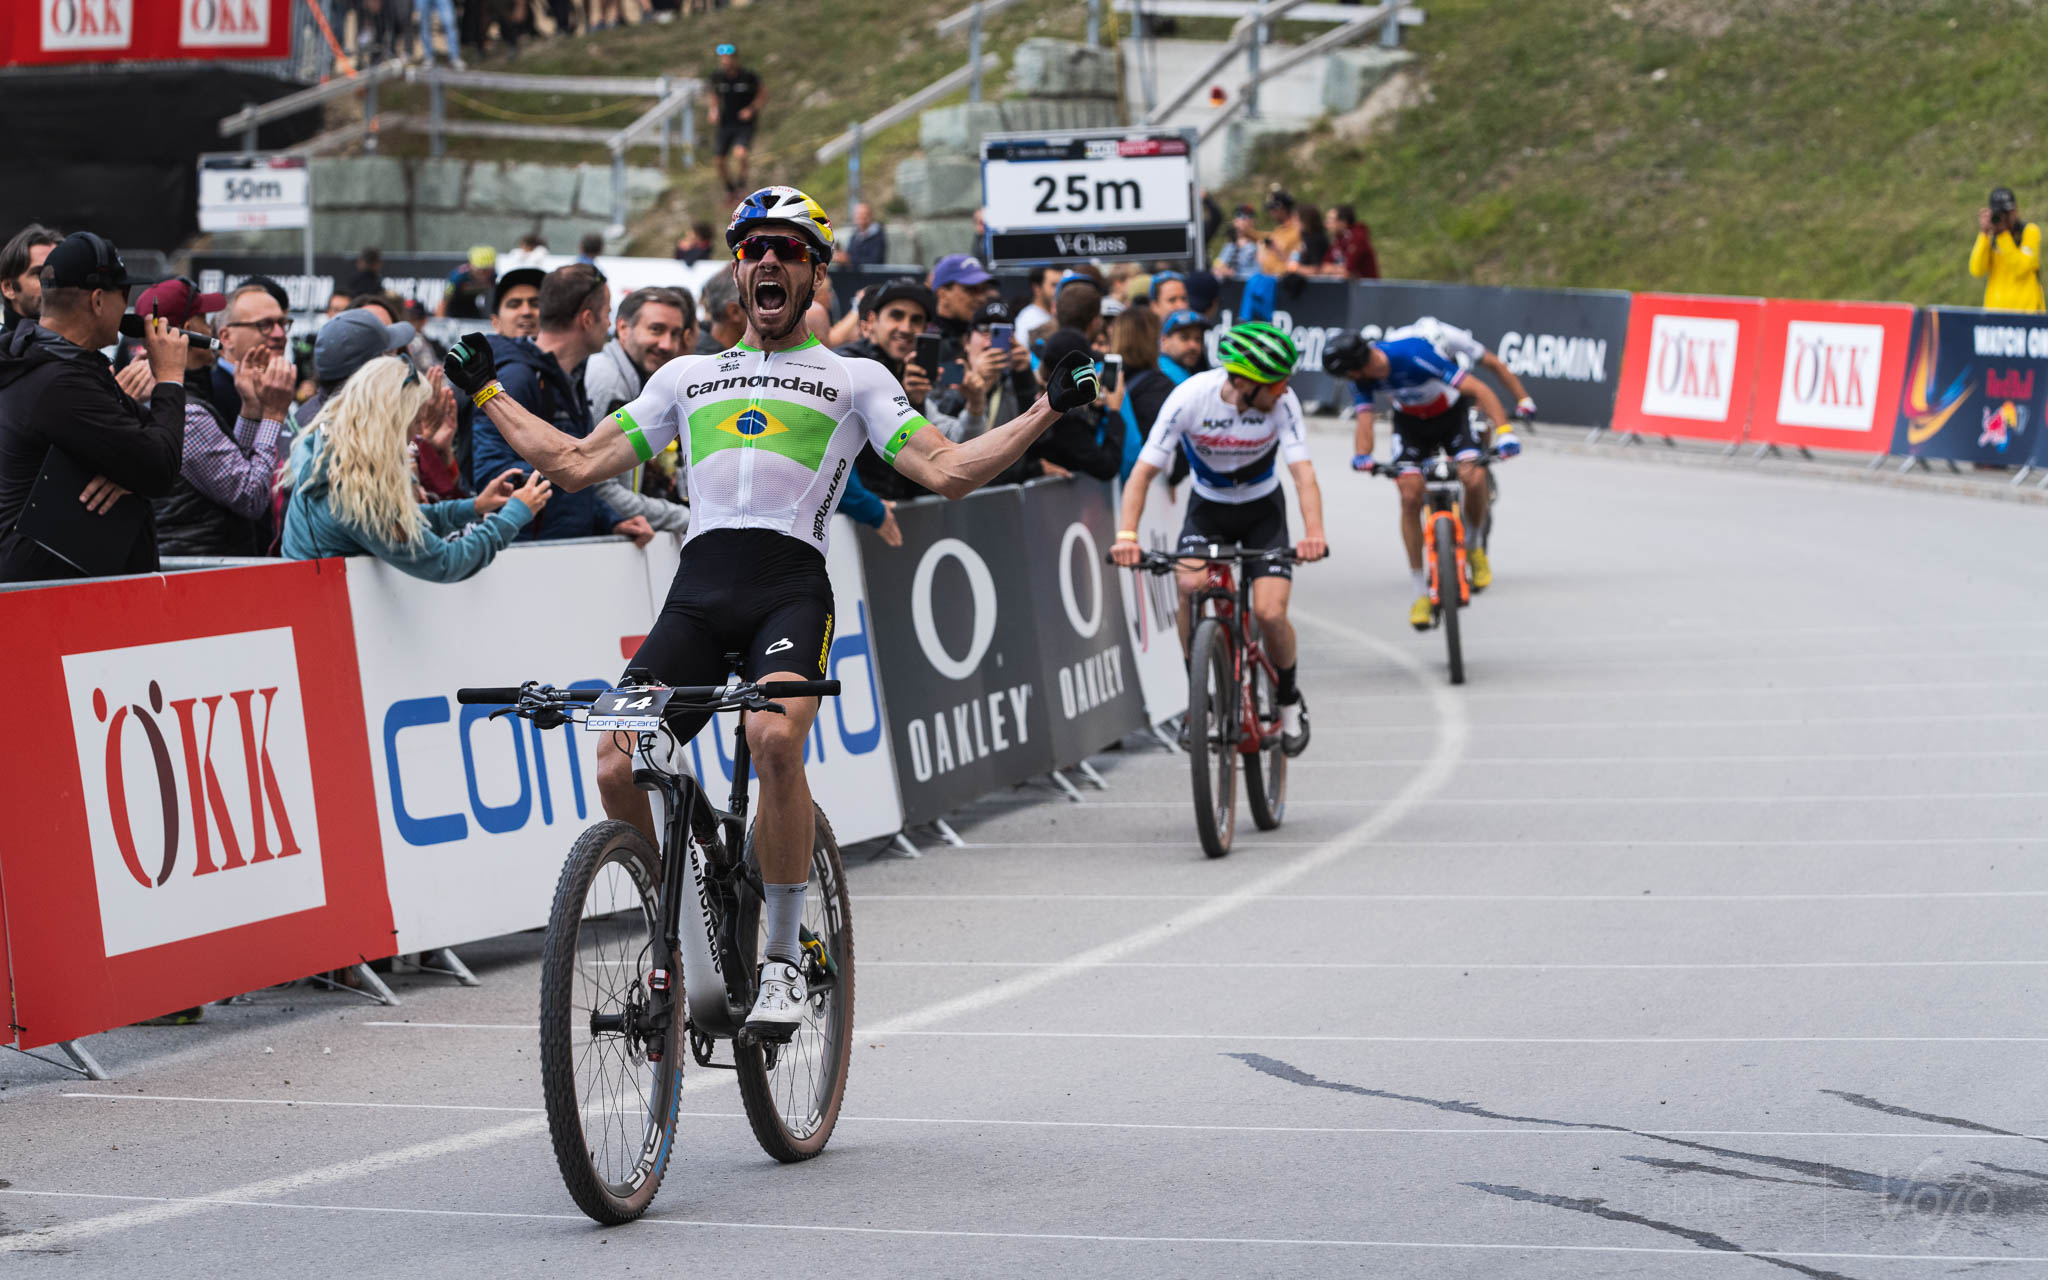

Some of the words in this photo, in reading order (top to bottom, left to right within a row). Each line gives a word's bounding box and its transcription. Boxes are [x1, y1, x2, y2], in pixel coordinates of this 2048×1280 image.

[225, 178, 282, 200] 50m
[1034, 175, 1142, 213] 25m
[1054, 233, 1127, 254] V-Class
[1498, 331, 1607, 383] GARMIN
[1793, 335, 1870, 407] ÖKK
[686, 374, 839, 403] cannondale
[812, 457, 847, 543] cannondale
[612, 696, 653, 711] 14
[1058, 645, 1125, 720] OAKLEY
[907, 683, 1030, 783] OAKLEY
[92, 679, 302, 889] ÖKK
